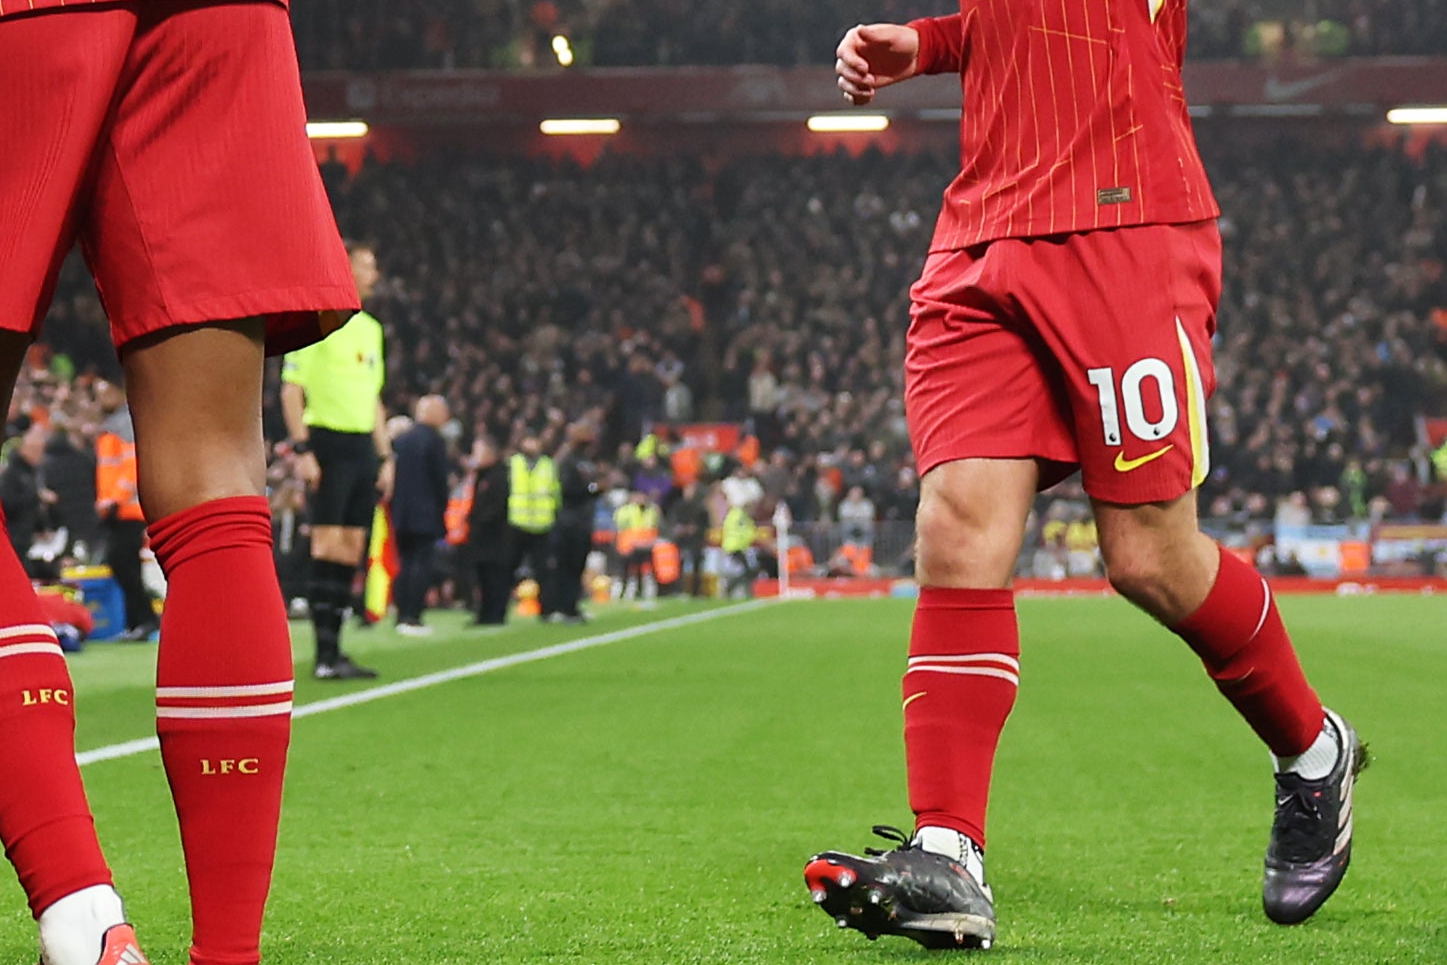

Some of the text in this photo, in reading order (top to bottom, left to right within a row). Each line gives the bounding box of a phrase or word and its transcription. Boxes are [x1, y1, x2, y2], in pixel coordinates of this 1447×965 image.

[1087, 357, 1179, 446] 10
[21, 689, 69, 706] LFC
[200, 758, 259, 775] LFC
